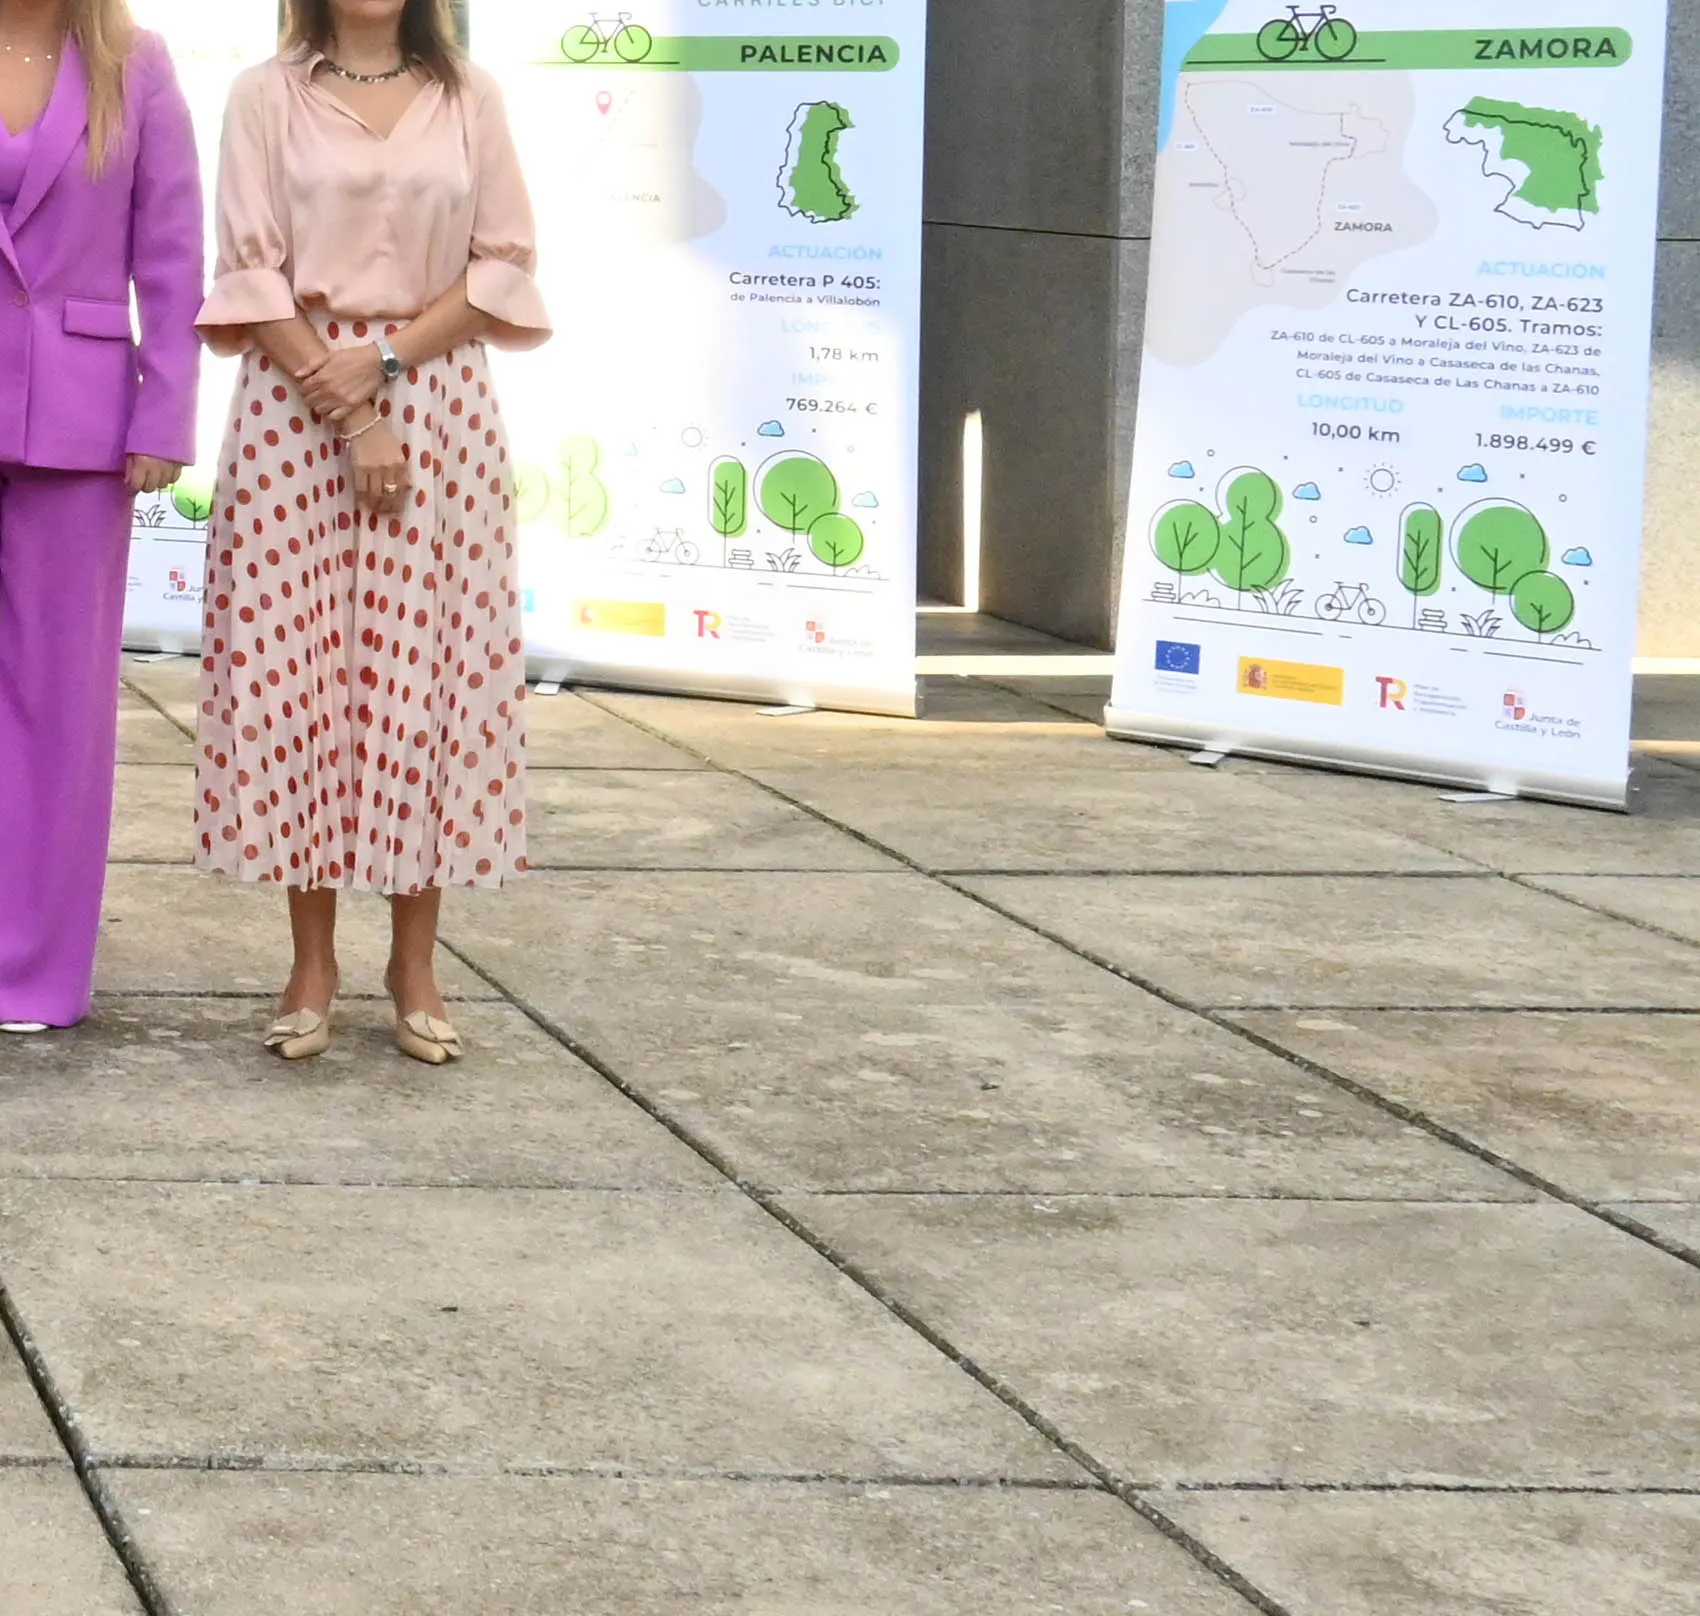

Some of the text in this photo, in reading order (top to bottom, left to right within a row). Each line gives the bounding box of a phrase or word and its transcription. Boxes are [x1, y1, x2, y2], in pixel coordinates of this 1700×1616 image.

[740, 44, 887, 64] PALENCIA
[1474, 37, 1617, 61] ZAMORA
[1334, 221, 1393, 233] ZAMORA
[729, 271, 881, 290] Carretera P 405:
[730, 292, 746, 302] de
[749, 292, 803, 304] Palencia
[806, 296, 814, 304] a
[1346, 288, 1604, 314] Carretera ZA-610, ZA-623
[1415, 314, 1603, 337] Y CL-605. Tramos:
[809, 346, 879, 362] 1,78 km
[1344, 371, 1362, 382] de
[1433, 376, 1452, 387] de
[1455, 377, 1480, 389] Las
[785, 397, 877, 415] 769.264 €
[1312, 421, 1400, 443] 10,00 km
[1475, 432, 1596, 456] 1.898.499 €
